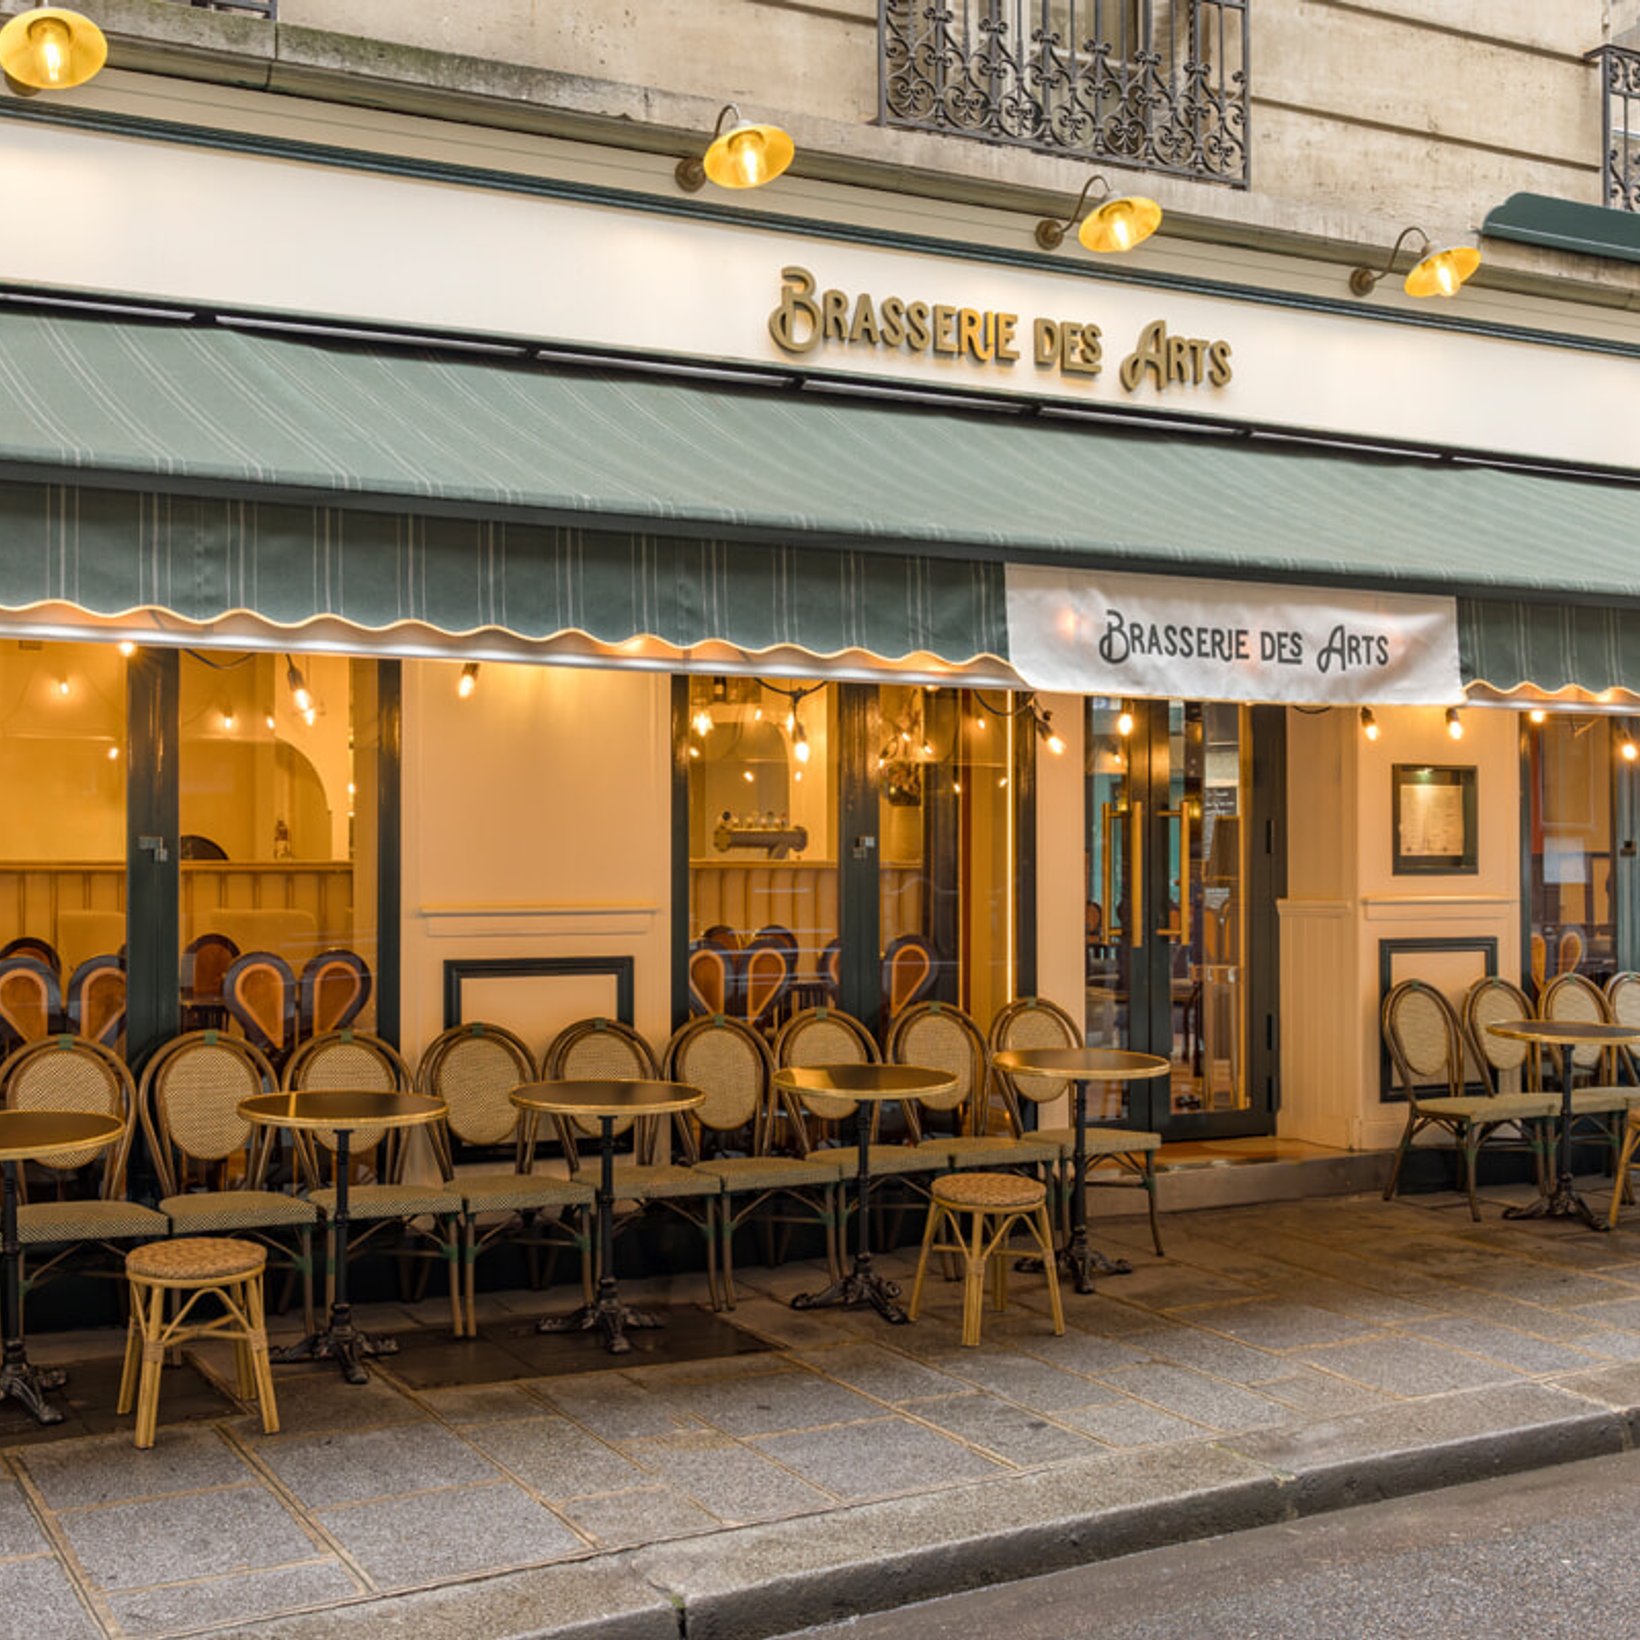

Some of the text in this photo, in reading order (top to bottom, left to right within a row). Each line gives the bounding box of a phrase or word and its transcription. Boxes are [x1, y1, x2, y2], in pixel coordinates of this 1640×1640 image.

[769, 267, 1232, 393] BRASSERIE DES ARTS
[1099, 609, 1389, 673] BRASSERIE DES ARTS
